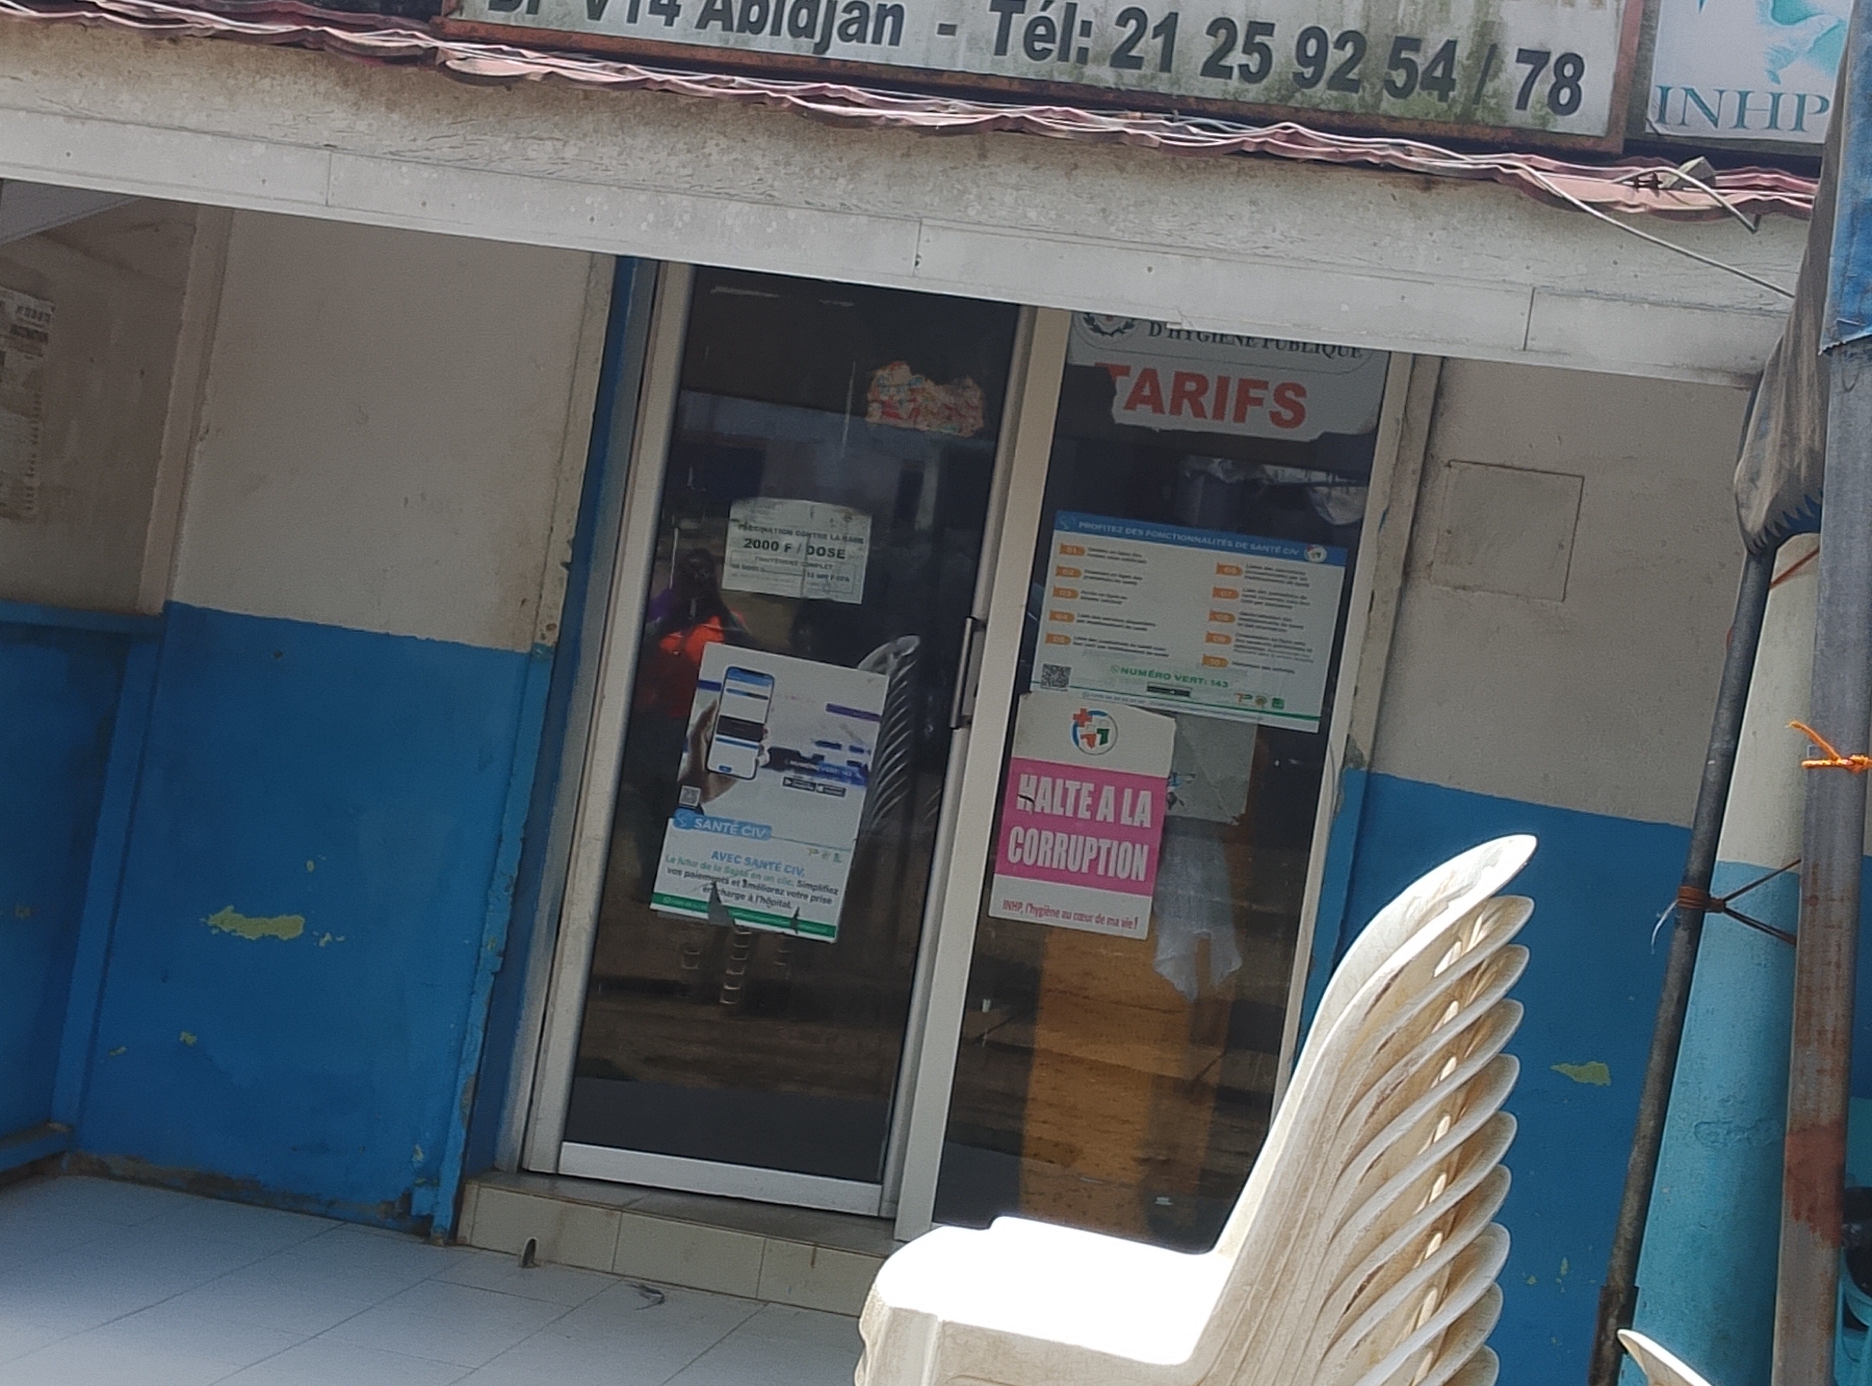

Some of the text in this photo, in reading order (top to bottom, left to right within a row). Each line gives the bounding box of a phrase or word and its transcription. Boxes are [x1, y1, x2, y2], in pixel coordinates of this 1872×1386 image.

[936, 20, 958, 37] -
[1109, 6, 1179, 74] 21
[1200, 14, 1276, 85] 25
[1292, 25, 1368, 95] 92
[1383, 34, 1459, 103] 54
[1512, 47, 1586, 116] 78
[1654, 84, 1831, 133] INHP
[1078, 520, 1124, 535] PROFITEZ
[743, 537, 779, 551] 2000
[784, 542, 792, 553] F
[806, 545, 846, 560] DOSE
[1119, 665, 1171, 681] NUMÉRO
[1016, 773, 1152, 828] HALTE A LA
[694, 817, 739, 835] SANTÉ
[711, 850, 741, 866] AVEC
[744, 856, 781, 873] SANTÉ
[1007, 826, 1149, 882] CORRUPTION
